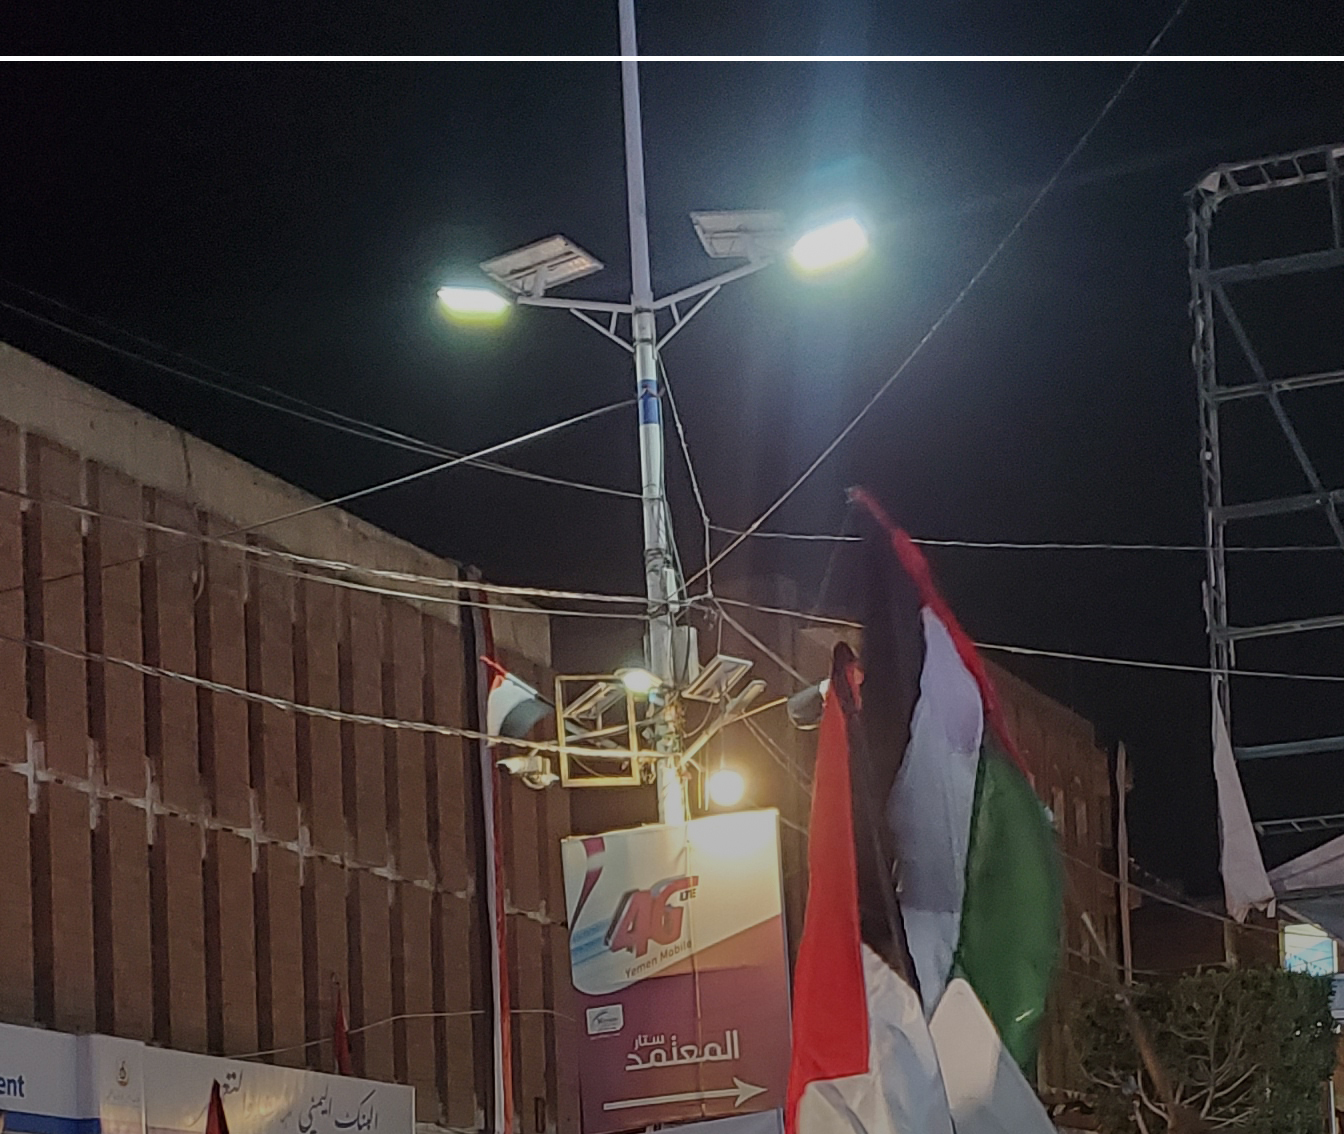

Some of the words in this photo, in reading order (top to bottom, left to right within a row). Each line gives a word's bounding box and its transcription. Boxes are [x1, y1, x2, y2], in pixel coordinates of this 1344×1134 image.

[625, 957, 658, 979] Yemen
[659, 940, 693, 962] Mobile
[624, 1029, 740, 1072] المعتمد
[633, 1034, 665, 1051] ستار
[334, 1089, 378, 1132] البنك
